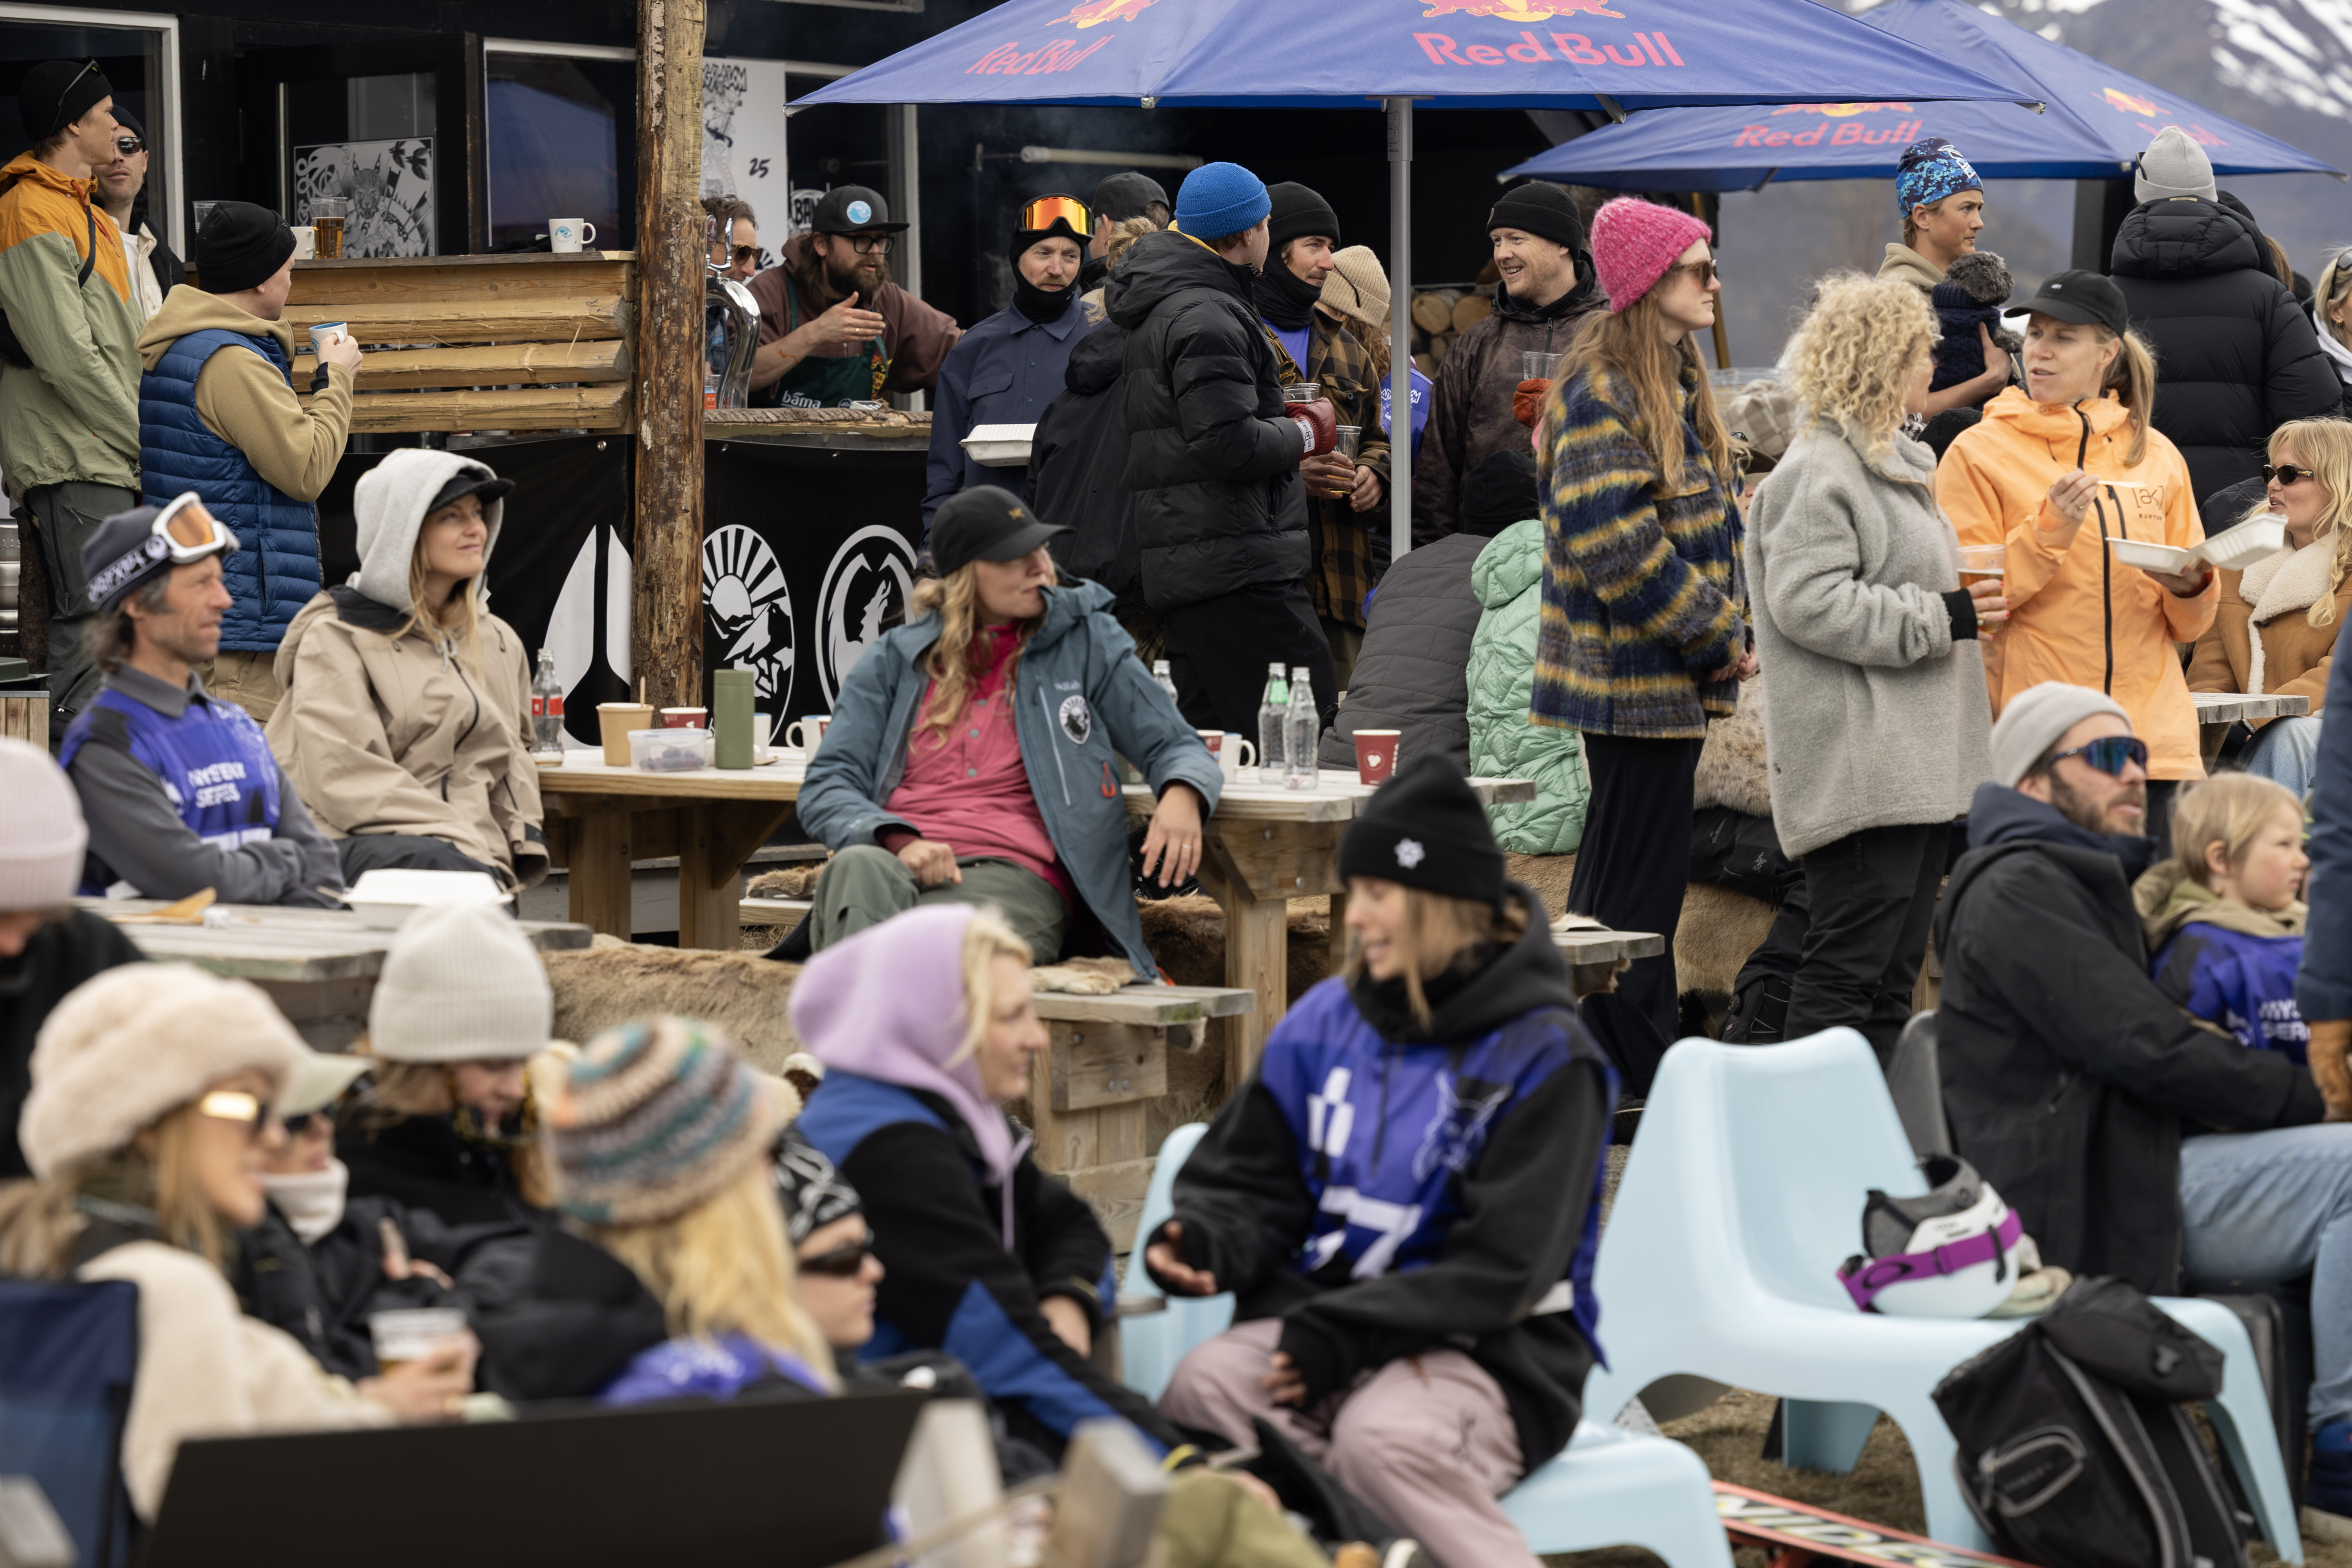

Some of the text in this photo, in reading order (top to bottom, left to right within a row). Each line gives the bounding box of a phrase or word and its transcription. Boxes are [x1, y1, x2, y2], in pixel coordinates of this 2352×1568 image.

[964, 34, 1116, 75] Red Bull
[1412, 31, 1686, 66] Red Bull
[1733, 120, 1924, 148] Red Bull
[749, 157, 771, 178] 25
